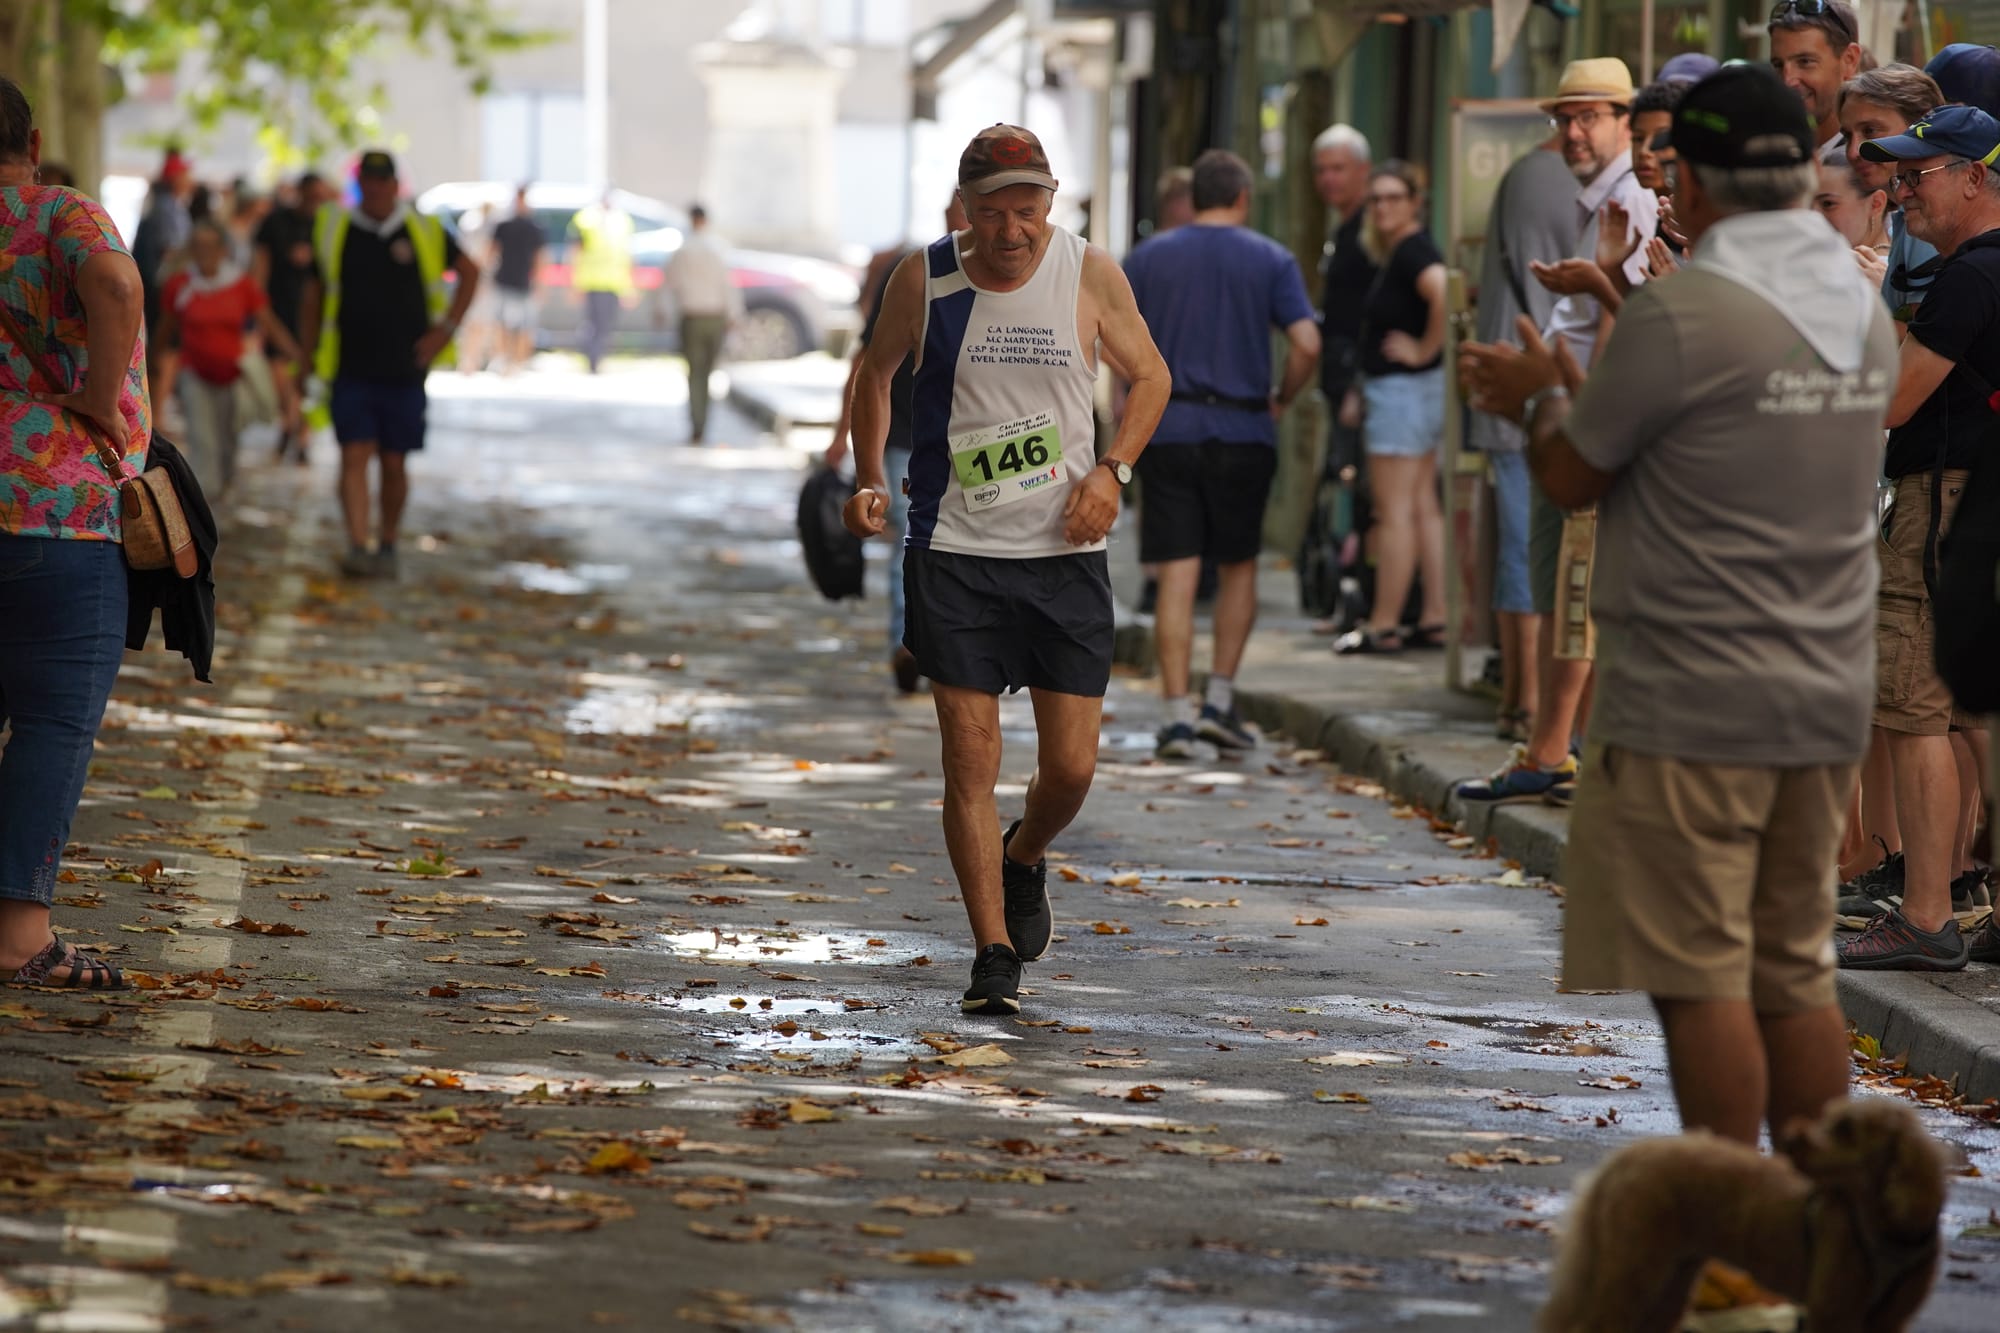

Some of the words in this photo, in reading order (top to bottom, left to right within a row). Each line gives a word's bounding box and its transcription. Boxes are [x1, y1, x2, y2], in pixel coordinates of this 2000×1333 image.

[1006, 326, 1054, 336] LANGOGNE
[1004, 337, 1056, 346] MARVEJOLS
[1001, 346, 1028, 354] CHELY
[1033, 347, 1072, 357] D'APCHER
[970, 355, 996, 363] EVEIL
[999, 356, 1041, 365] MENDOIS
[999, 418, 1032, 432] Challenge
[972, 436, 1049, 481] 146
